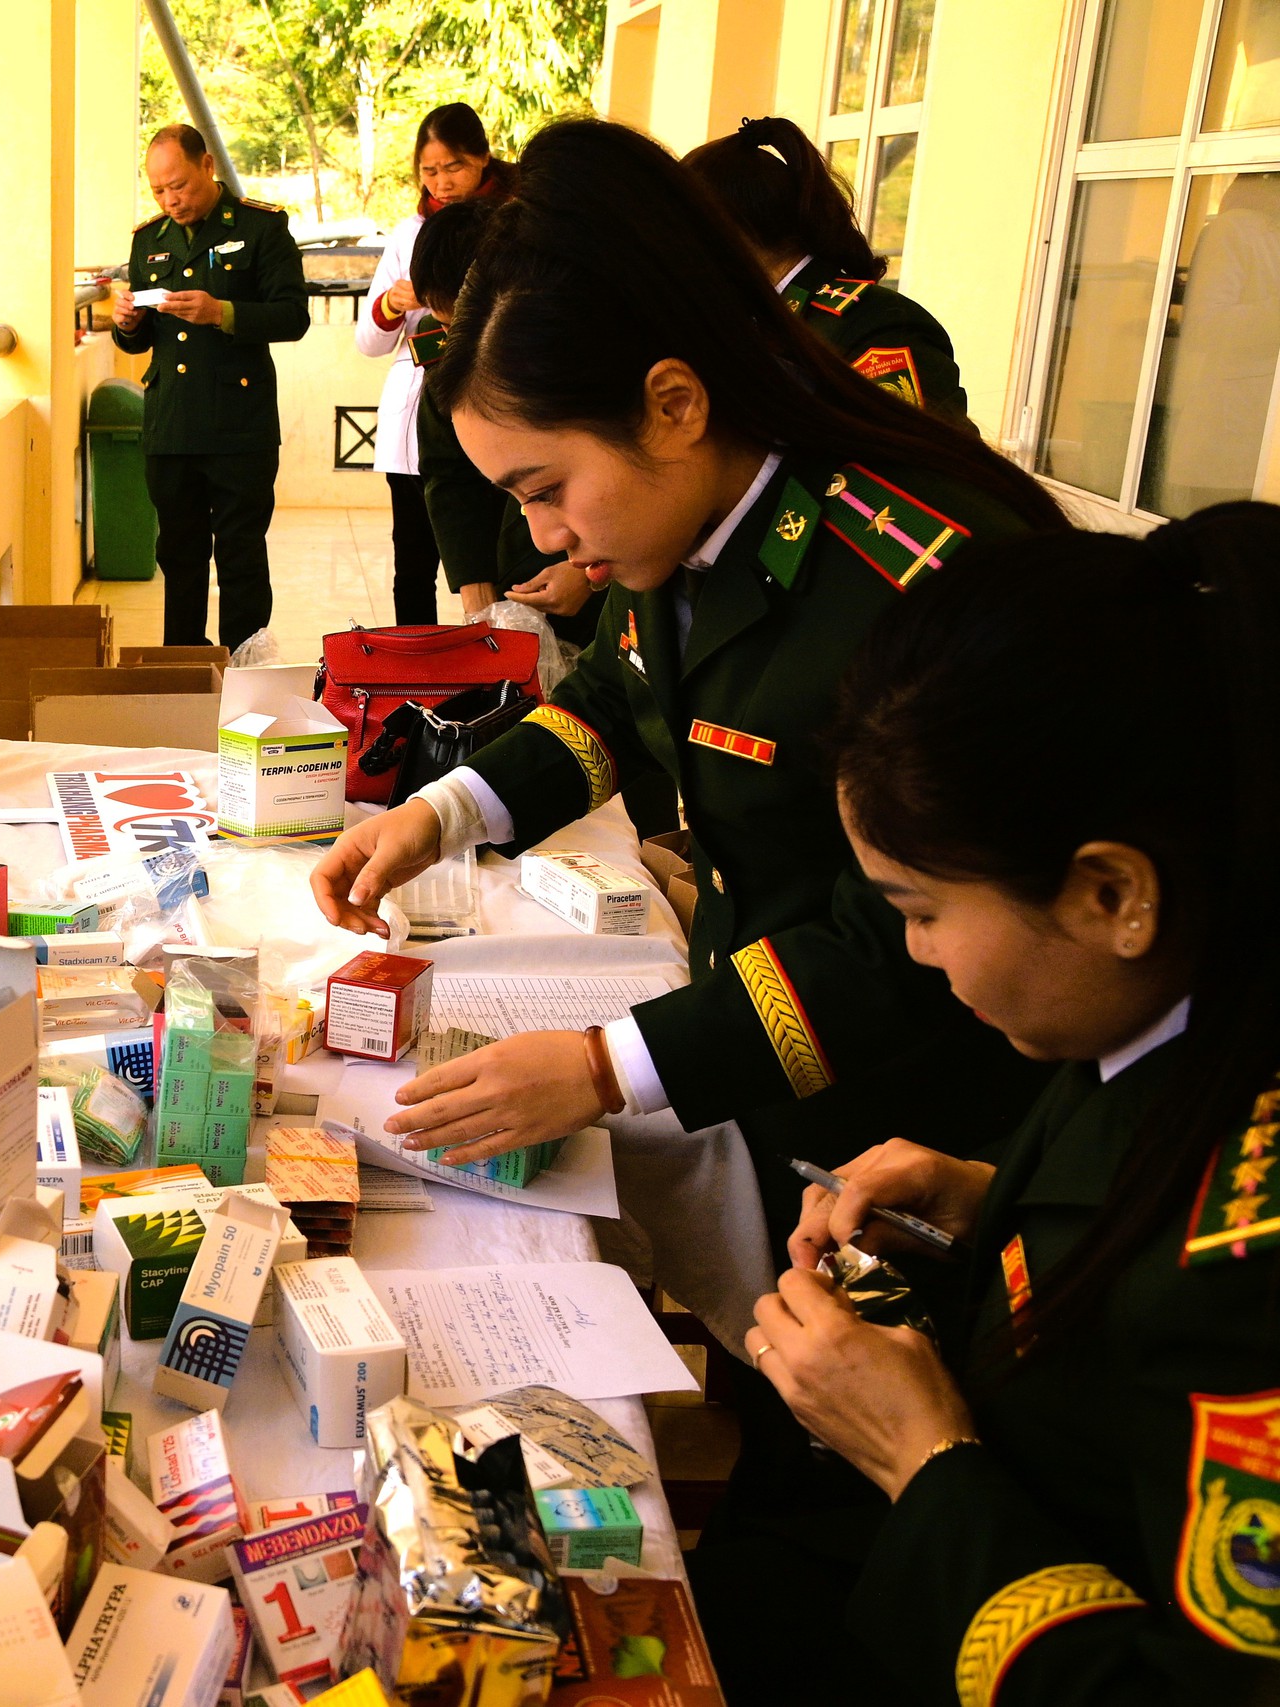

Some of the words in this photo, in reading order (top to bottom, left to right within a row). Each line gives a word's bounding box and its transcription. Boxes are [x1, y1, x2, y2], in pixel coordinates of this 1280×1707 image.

[330, 761, 343, 770] HD
[607, 893, 642, 903] Piracetam
[58, 957, 103, 966] Stadxicam
[105, 955, 118, 963] 7.5
[202, 1245, 230, 1299] Myopain
[222, 1225, 238, 1243] 50
[258, 1238, 272, 1266] STELLA
[140, 1264, 189, 1279] Stacytine
[140, 1278, 165, 1289] CAP
[356, 1361, 367, 1381] 200
[355, 1385, 366, 1438] EUXAMUS
[162, 1434, 175, 1454] T25
[244, 1513, 363, 1564] MEBENDAZOL
[262, 1581, 316, 1645] 1
[73, 1582, 127, 1688] ALPHATRYPA
